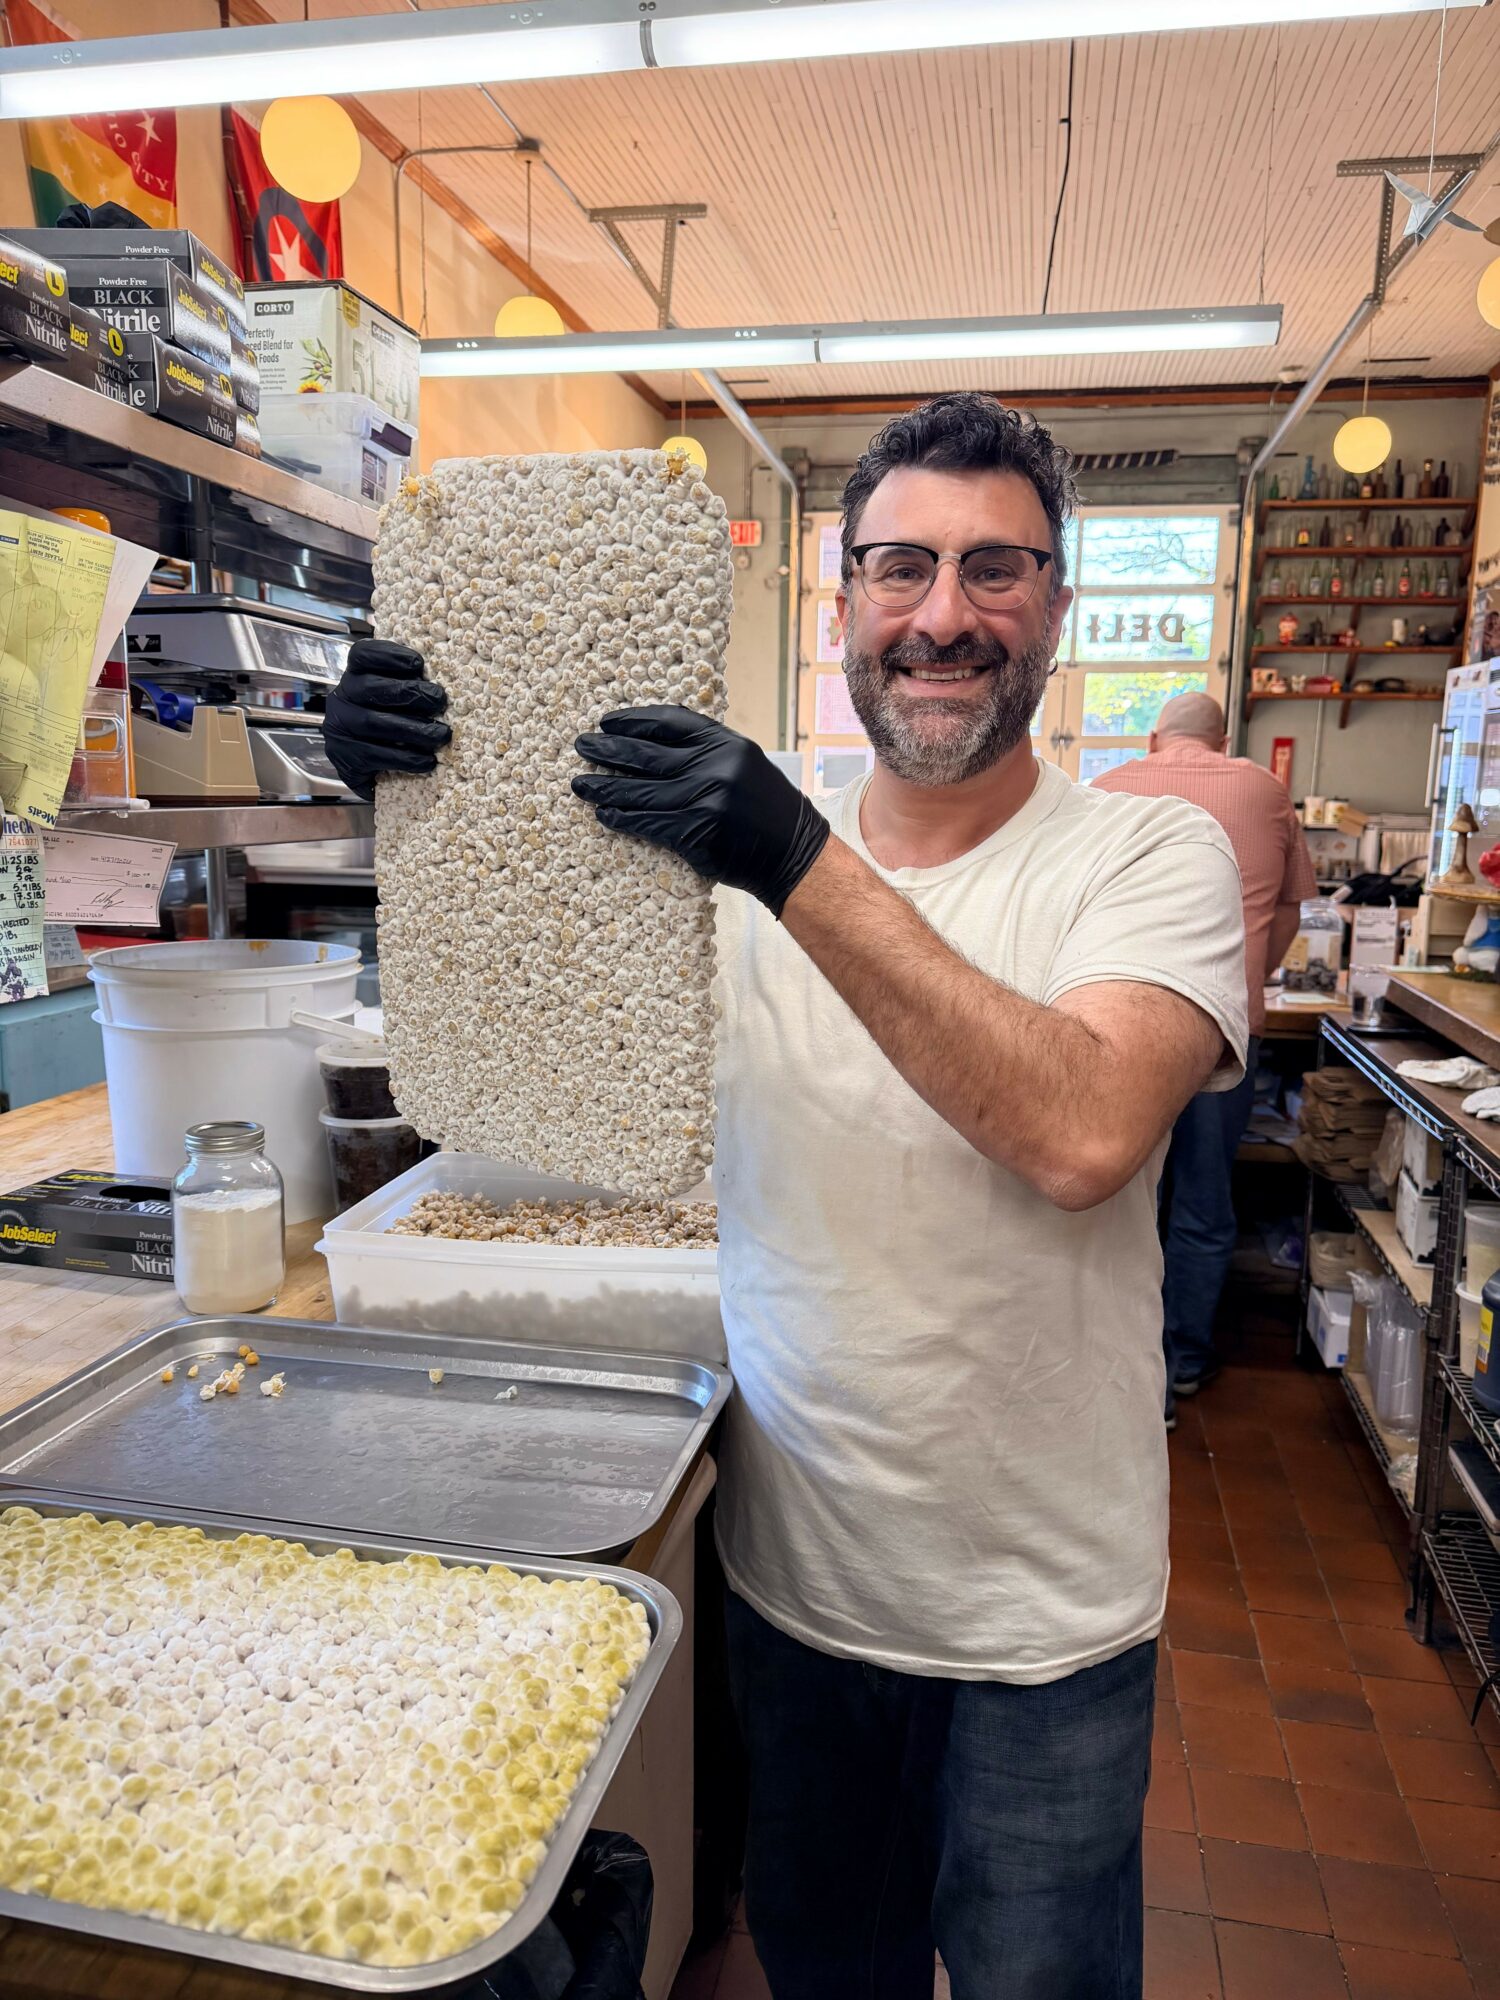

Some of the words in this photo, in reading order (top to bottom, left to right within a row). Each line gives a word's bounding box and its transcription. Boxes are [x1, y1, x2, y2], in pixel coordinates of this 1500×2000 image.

[131, 151, 168, 192] CITY
[125, 246, 152, 254] Powder
[153, 246, 170, 254] Free
[98, 277, 128, 286] Powder
[129, 277, 147, 286] Free
[93, 289, 154, 305] BLACK
[29, 301, 64, 329] BLACK
[256, 303, 291, 313] CORTO
[86, 308, 161, 333] Nitrile
[25, 315, 67, 352] Nitrile
[245, 327, 275, 340] Perfectly
[263, 340, 282, 351] Blend
[283, 339, 294, 350] for
[259, 353, 280, 363] Foods
[97, 361, 125, 384] BLACK
[166, 360, 205, 393] JobSelect
[94, 373, 127, 403] Nitrile
[211, 405, 232, 424] BLACK
[206, 415, 234, 442] Nitrile
[45, 552, 64, 562] PLEASE
[28, 805, 56, 825] Meats
[69, 1199, 125, 1211] BLACK
[0, 1224, 57, 1245] JobSelect
[139, 1231, 161, 1239] Powder
[135, 1240, 174, 1255] BLAC
[131, 1254, 174, 1276] Nitril
